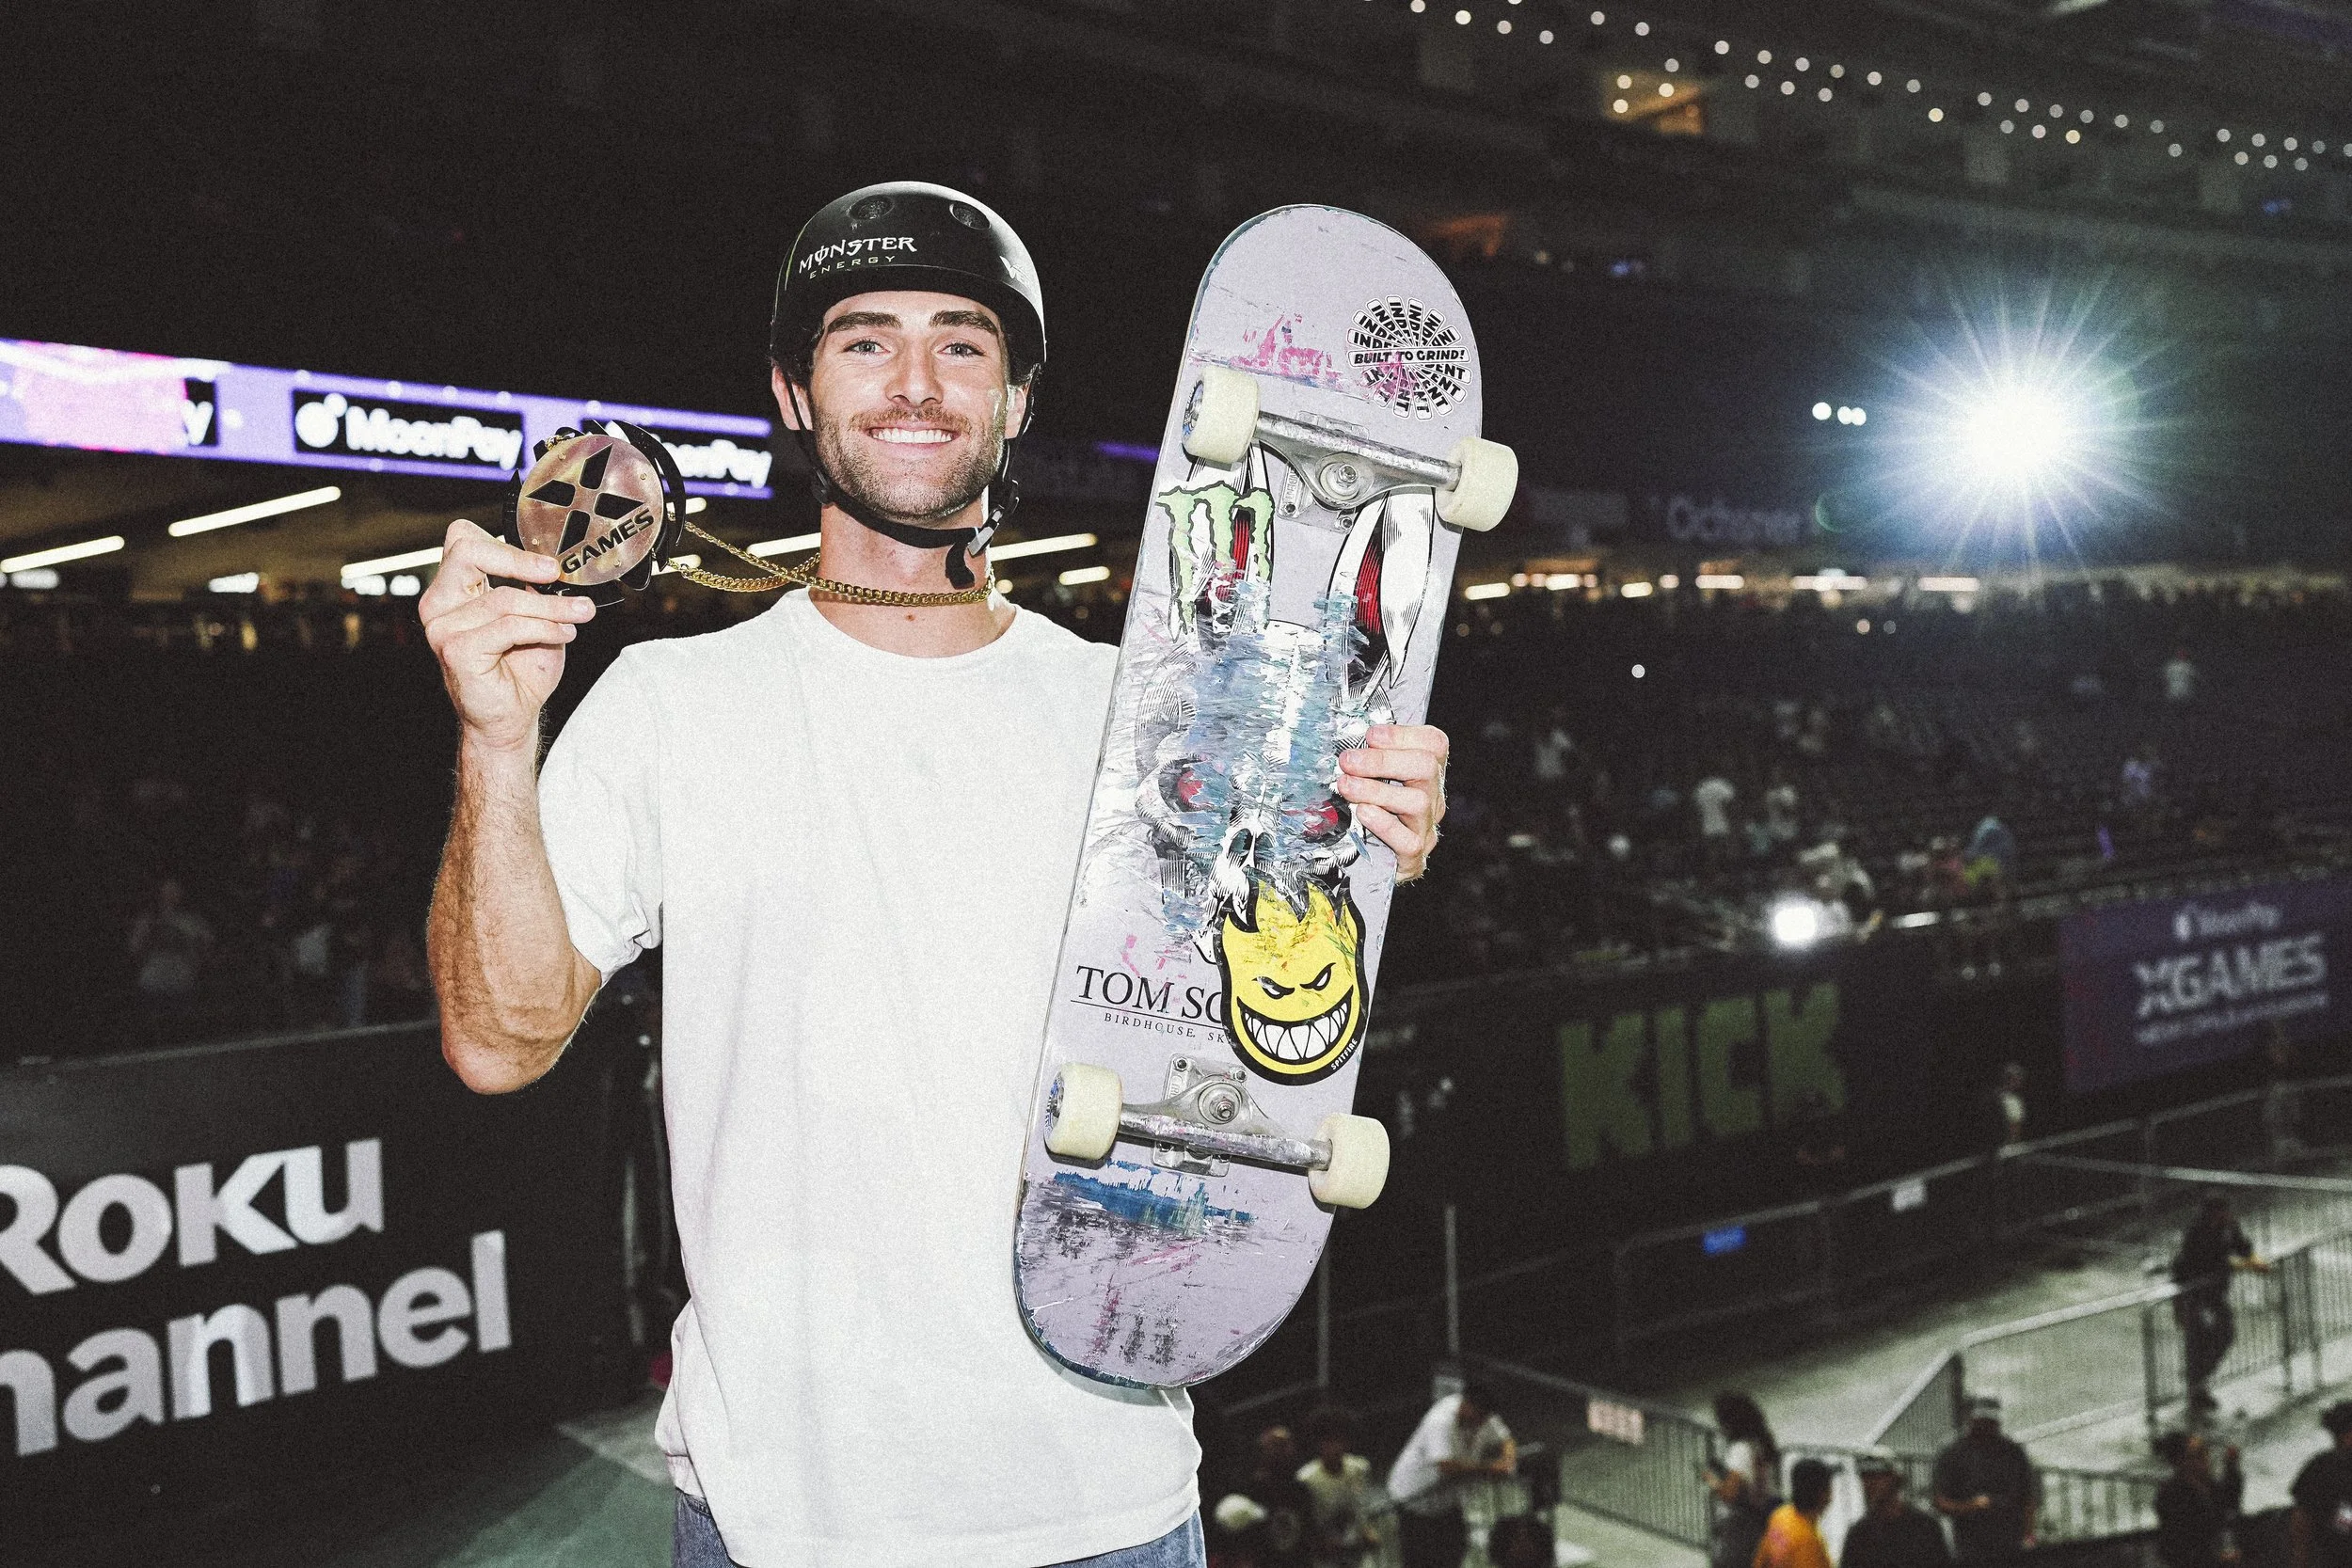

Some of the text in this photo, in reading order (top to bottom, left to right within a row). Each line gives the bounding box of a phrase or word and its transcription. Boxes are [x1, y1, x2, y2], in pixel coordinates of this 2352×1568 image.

[809, 255, 896, 279] ENERGY
[1354, 350, 1465, 364] BUILT TO GRIND!
[653, 425, 772, 489] oonPay
[560, 507, 655, 575] GAMES
[1076, 965, 1175, 1013] TOM
[1330, 1037, 1358, 1070] SPITFIRE
[1560, 983, 1845, 1169] KICK
